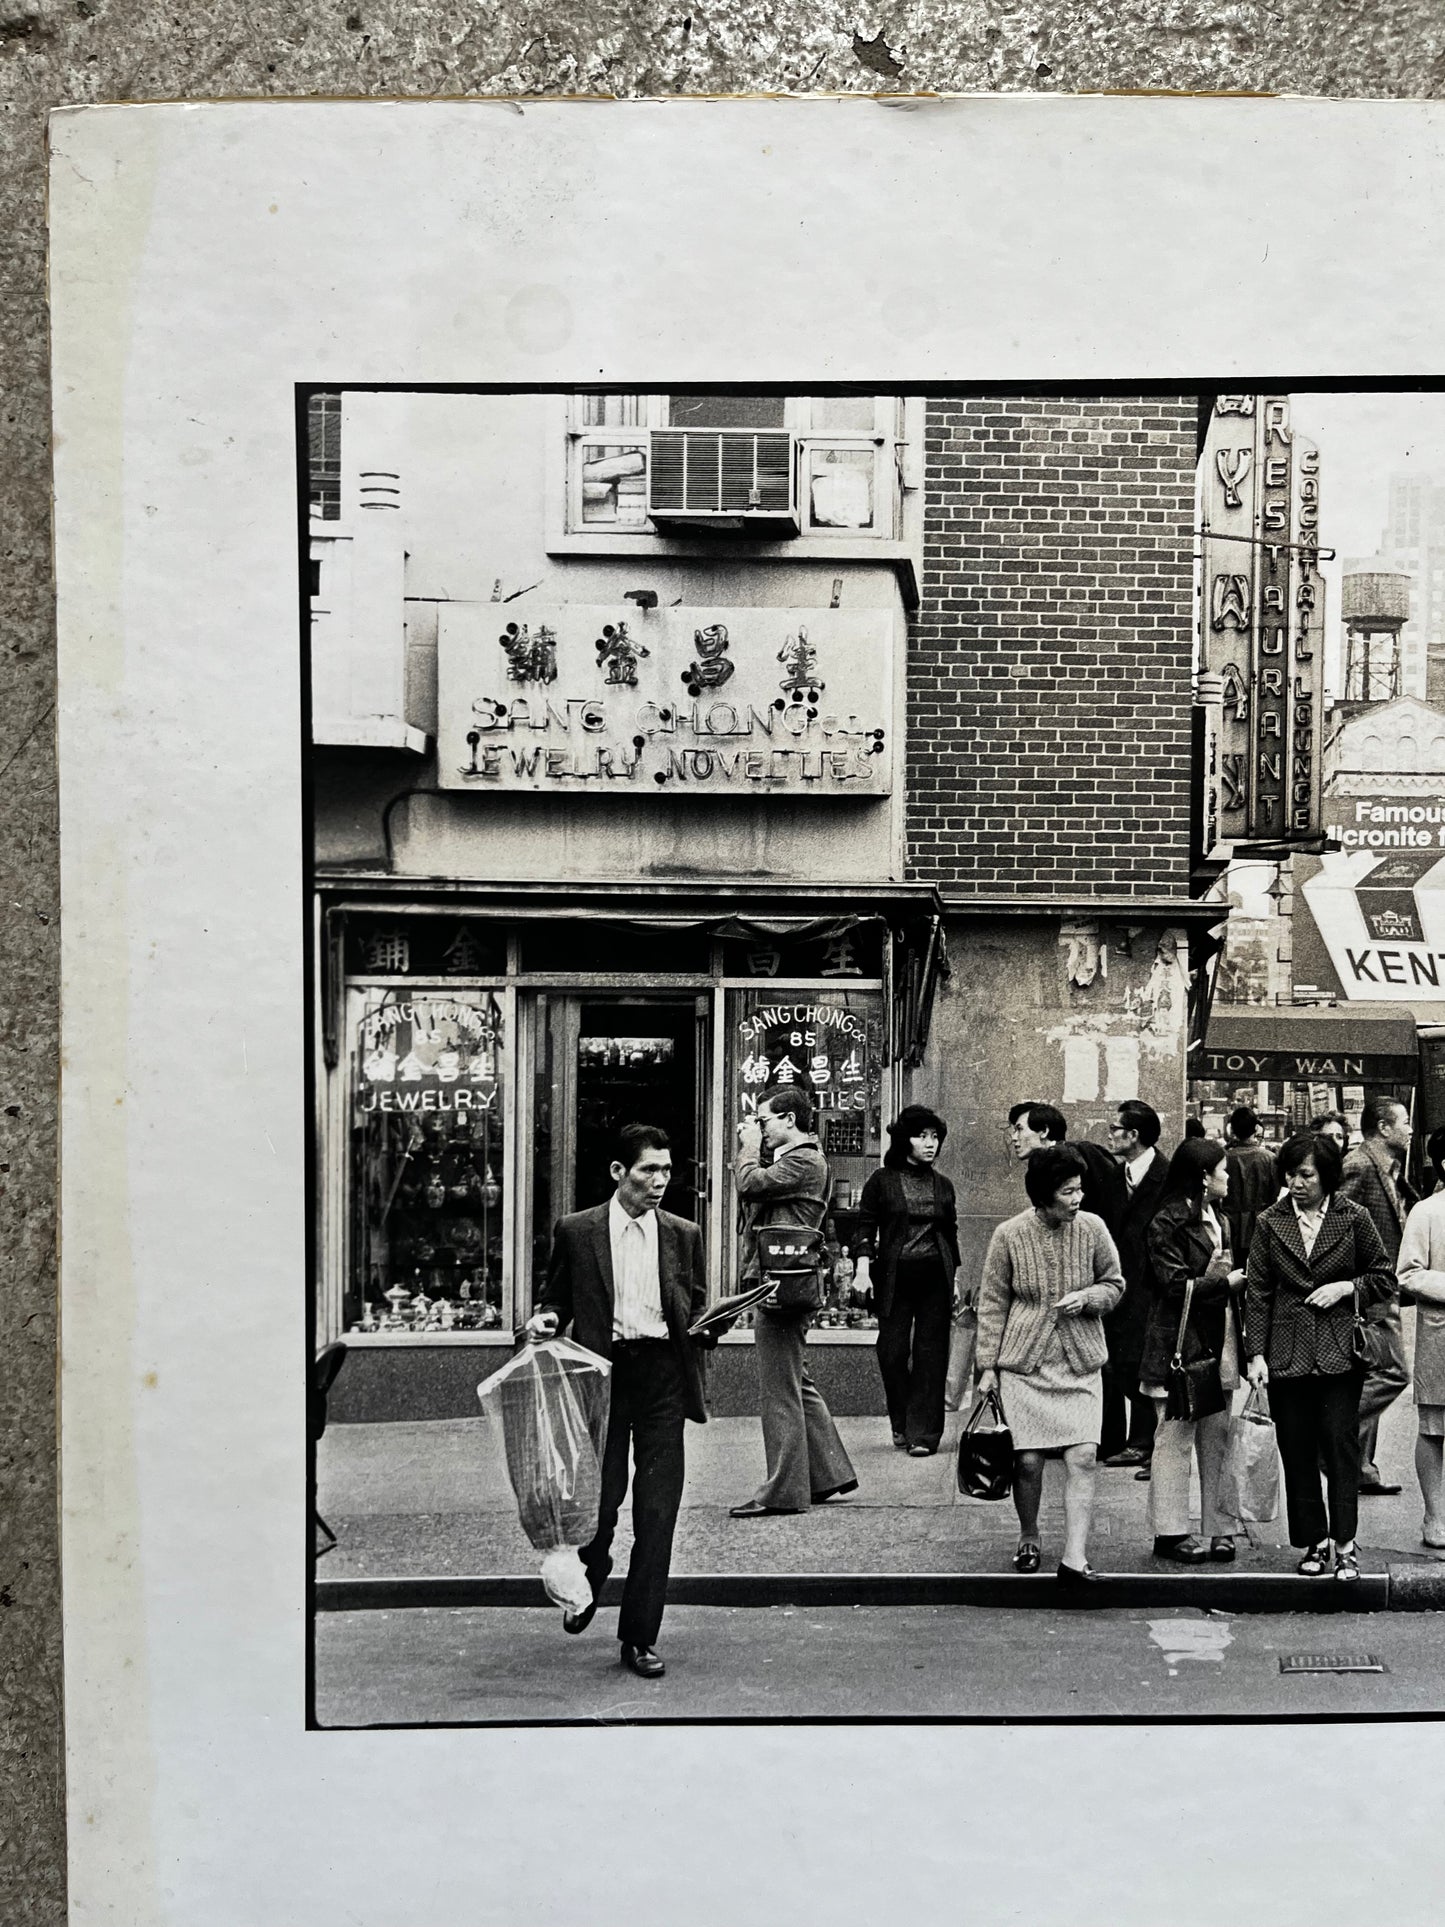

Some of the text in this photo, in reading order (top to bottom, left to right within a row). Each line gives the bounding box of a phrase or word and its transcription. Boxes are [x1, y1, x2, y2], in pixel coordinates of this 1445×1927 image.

[1260, 401, 1290, 823] RESTAURANT
[1294, 451, 1319, 830] COCKTAIL LOUNGE
[471, 697, 607, 731] SANG
[635, 700, 815, 735] CHONG
[457, 744, 875, 780] JEWELRY NOVELTIES
[739, 1006, 791, 1041] SANG
[793, 1004, 857, 1033] CHONG
[790, 1030, 817, 1047] 85
[1207, 1054, 1364, 1075] TOY WAN
[361, 1084, 498, 1112] JEWELRY
